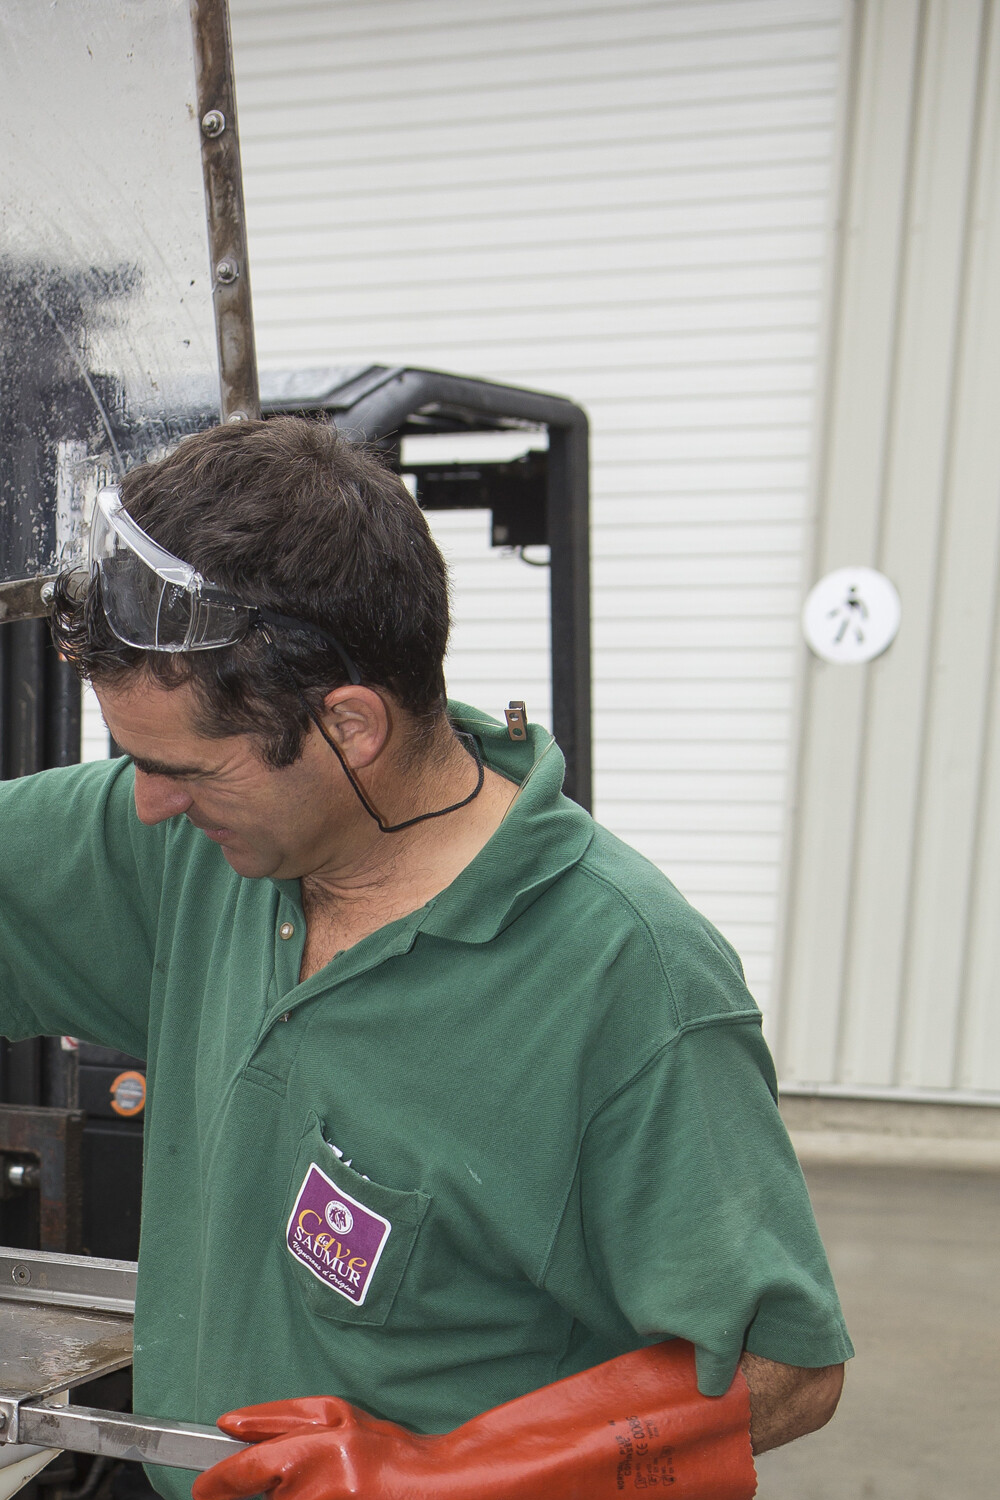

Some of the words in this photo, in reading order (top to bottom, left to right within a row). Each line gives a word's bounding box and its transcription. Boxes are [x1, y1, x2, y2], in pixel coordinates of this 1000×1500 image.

[294, 1226, 360, 1287] SAUMUR
[298, 1209, 367, 1273] Cave
[318, 1236, 329, 1246] de
[292, 1240, 322, 1271] Vignerons
[322, 1270, 356, 1295] d'Origine
[626, 1415, 645, 1439] 0086
[636, 1443, 648, 1456] CE
